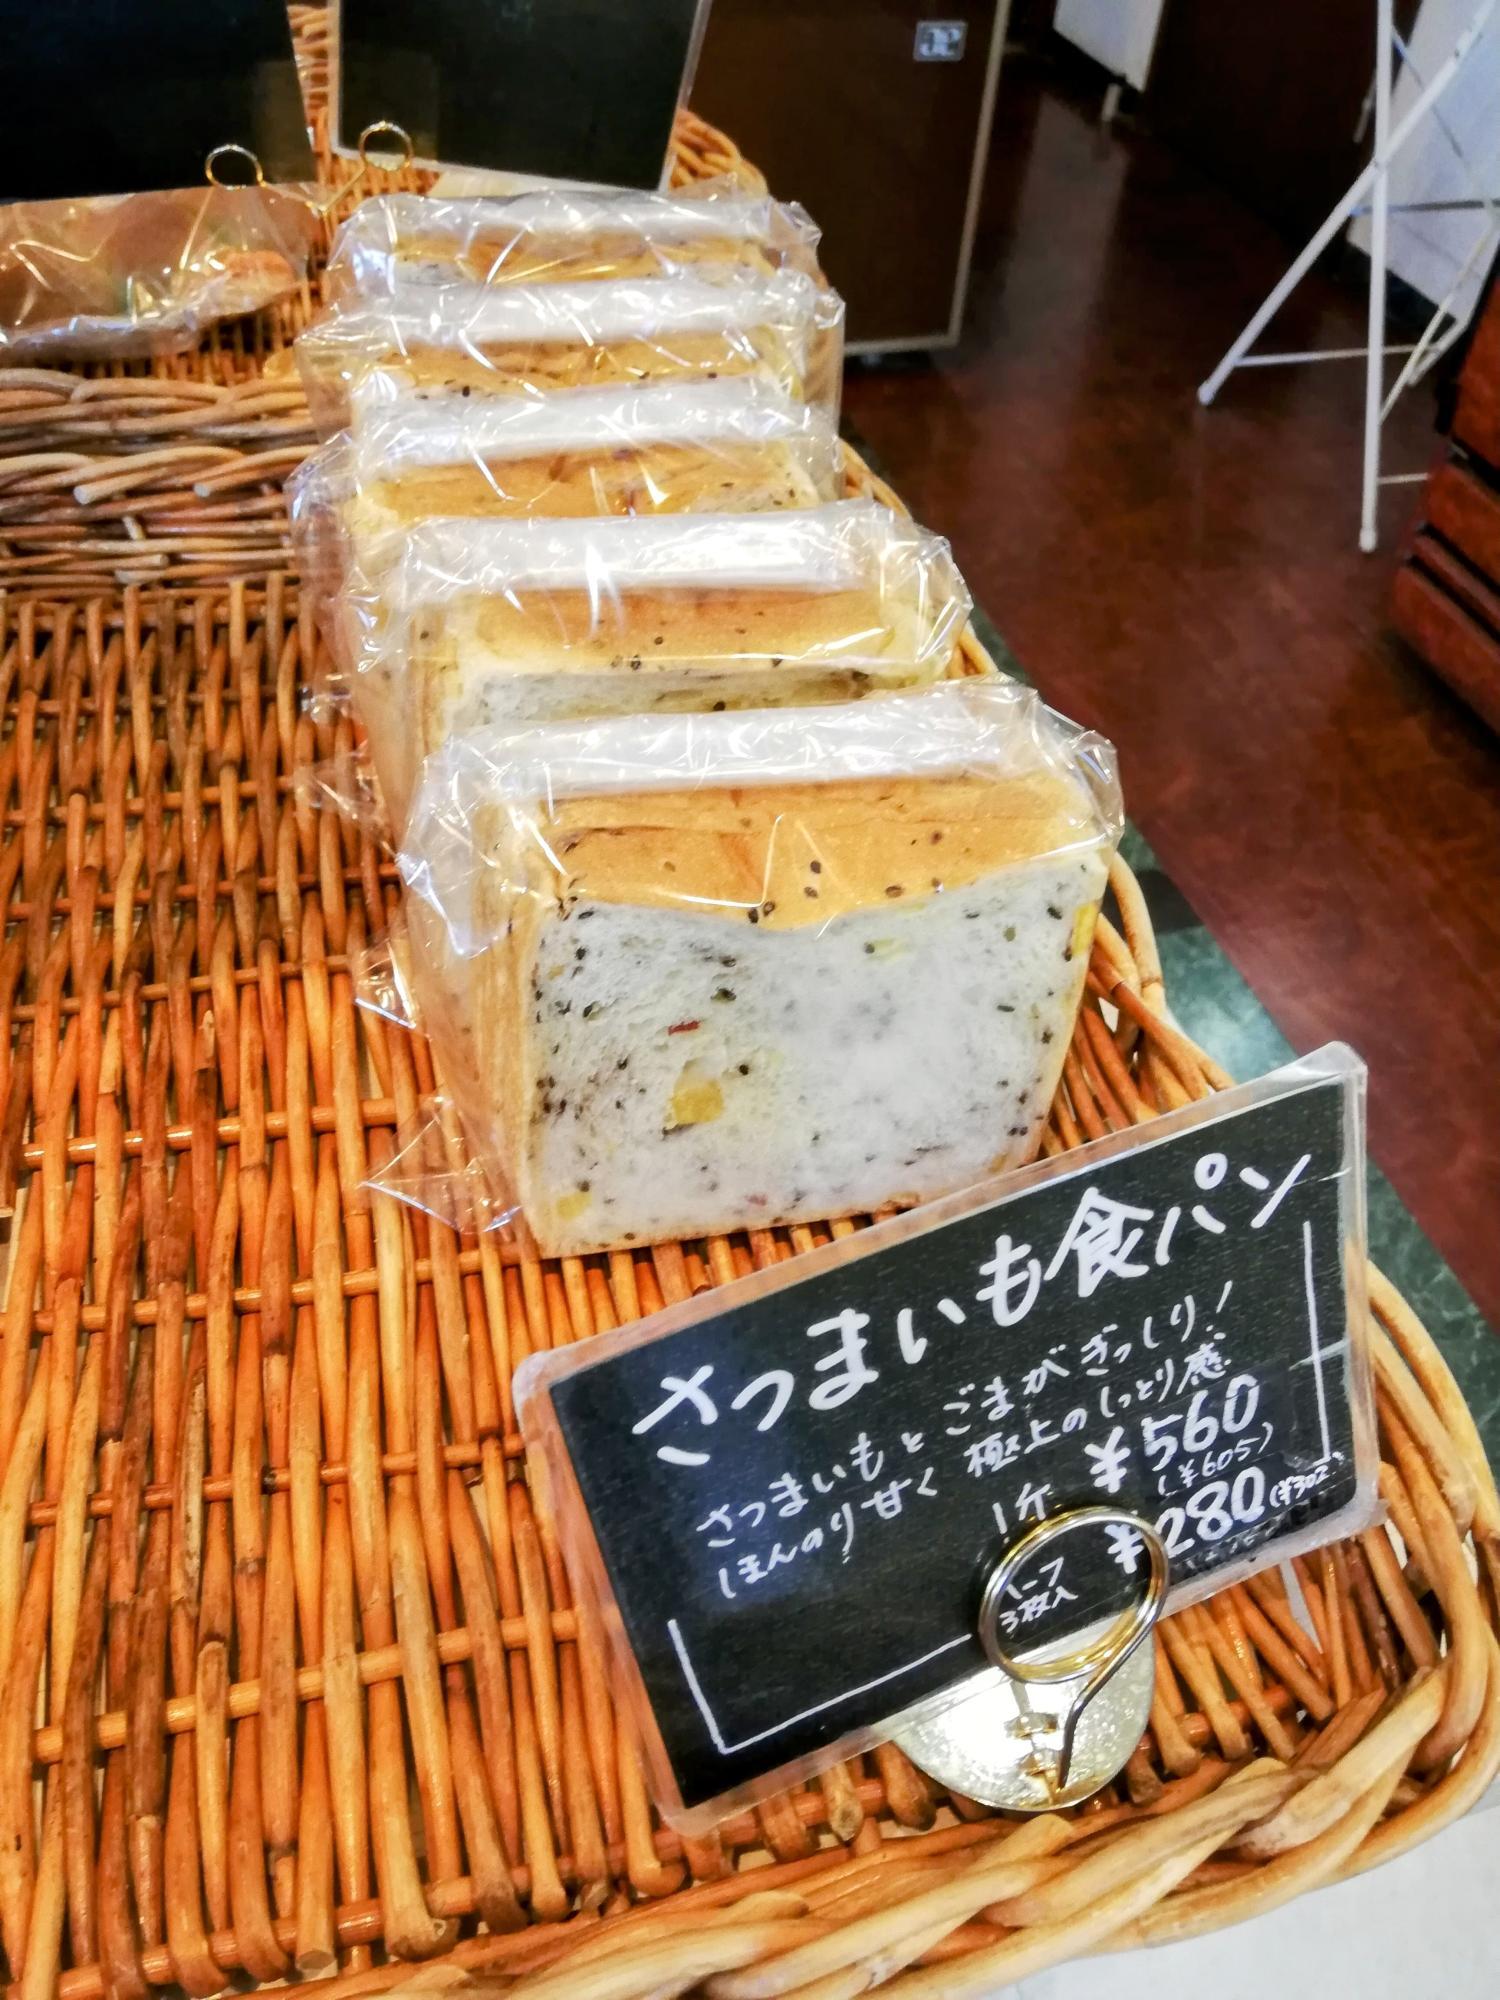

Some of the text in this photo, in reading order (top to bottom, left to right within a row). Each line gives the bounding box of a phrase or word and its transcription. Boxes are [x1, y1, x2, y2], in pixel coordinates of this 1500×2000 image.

[632, 1153, 1311, 1466] さつまいも食パン
[1084, 1374, 1260, 1493] ¥560
[999, 1586, 1079, 1634] 3枚入
